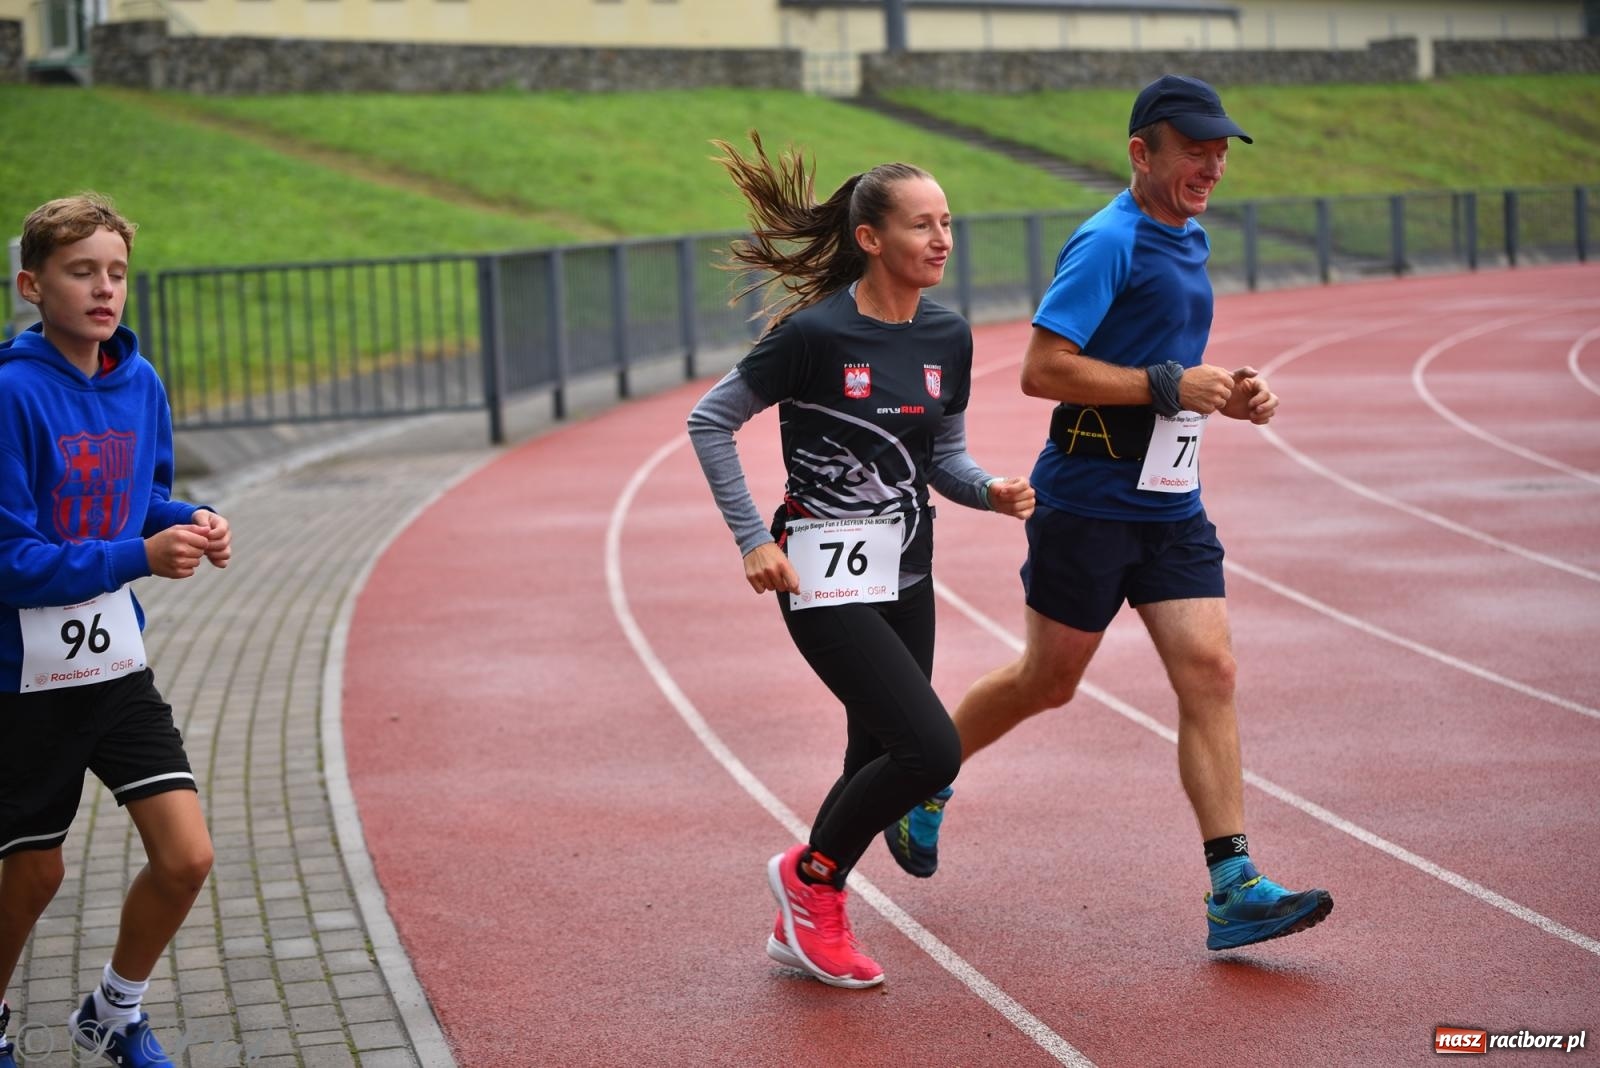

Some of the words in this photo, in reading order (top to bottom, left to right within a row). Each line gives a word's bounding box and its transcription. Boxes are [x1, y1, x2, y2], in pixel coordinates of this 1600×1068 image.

[819, 541, 868, 578] 76
[815, 588, 859, 600] Racibórz
[61, 613, 111, 660] 96
[51, 667, 101, 682] Racibórz
[111, 659, 134, 672] OSiR
